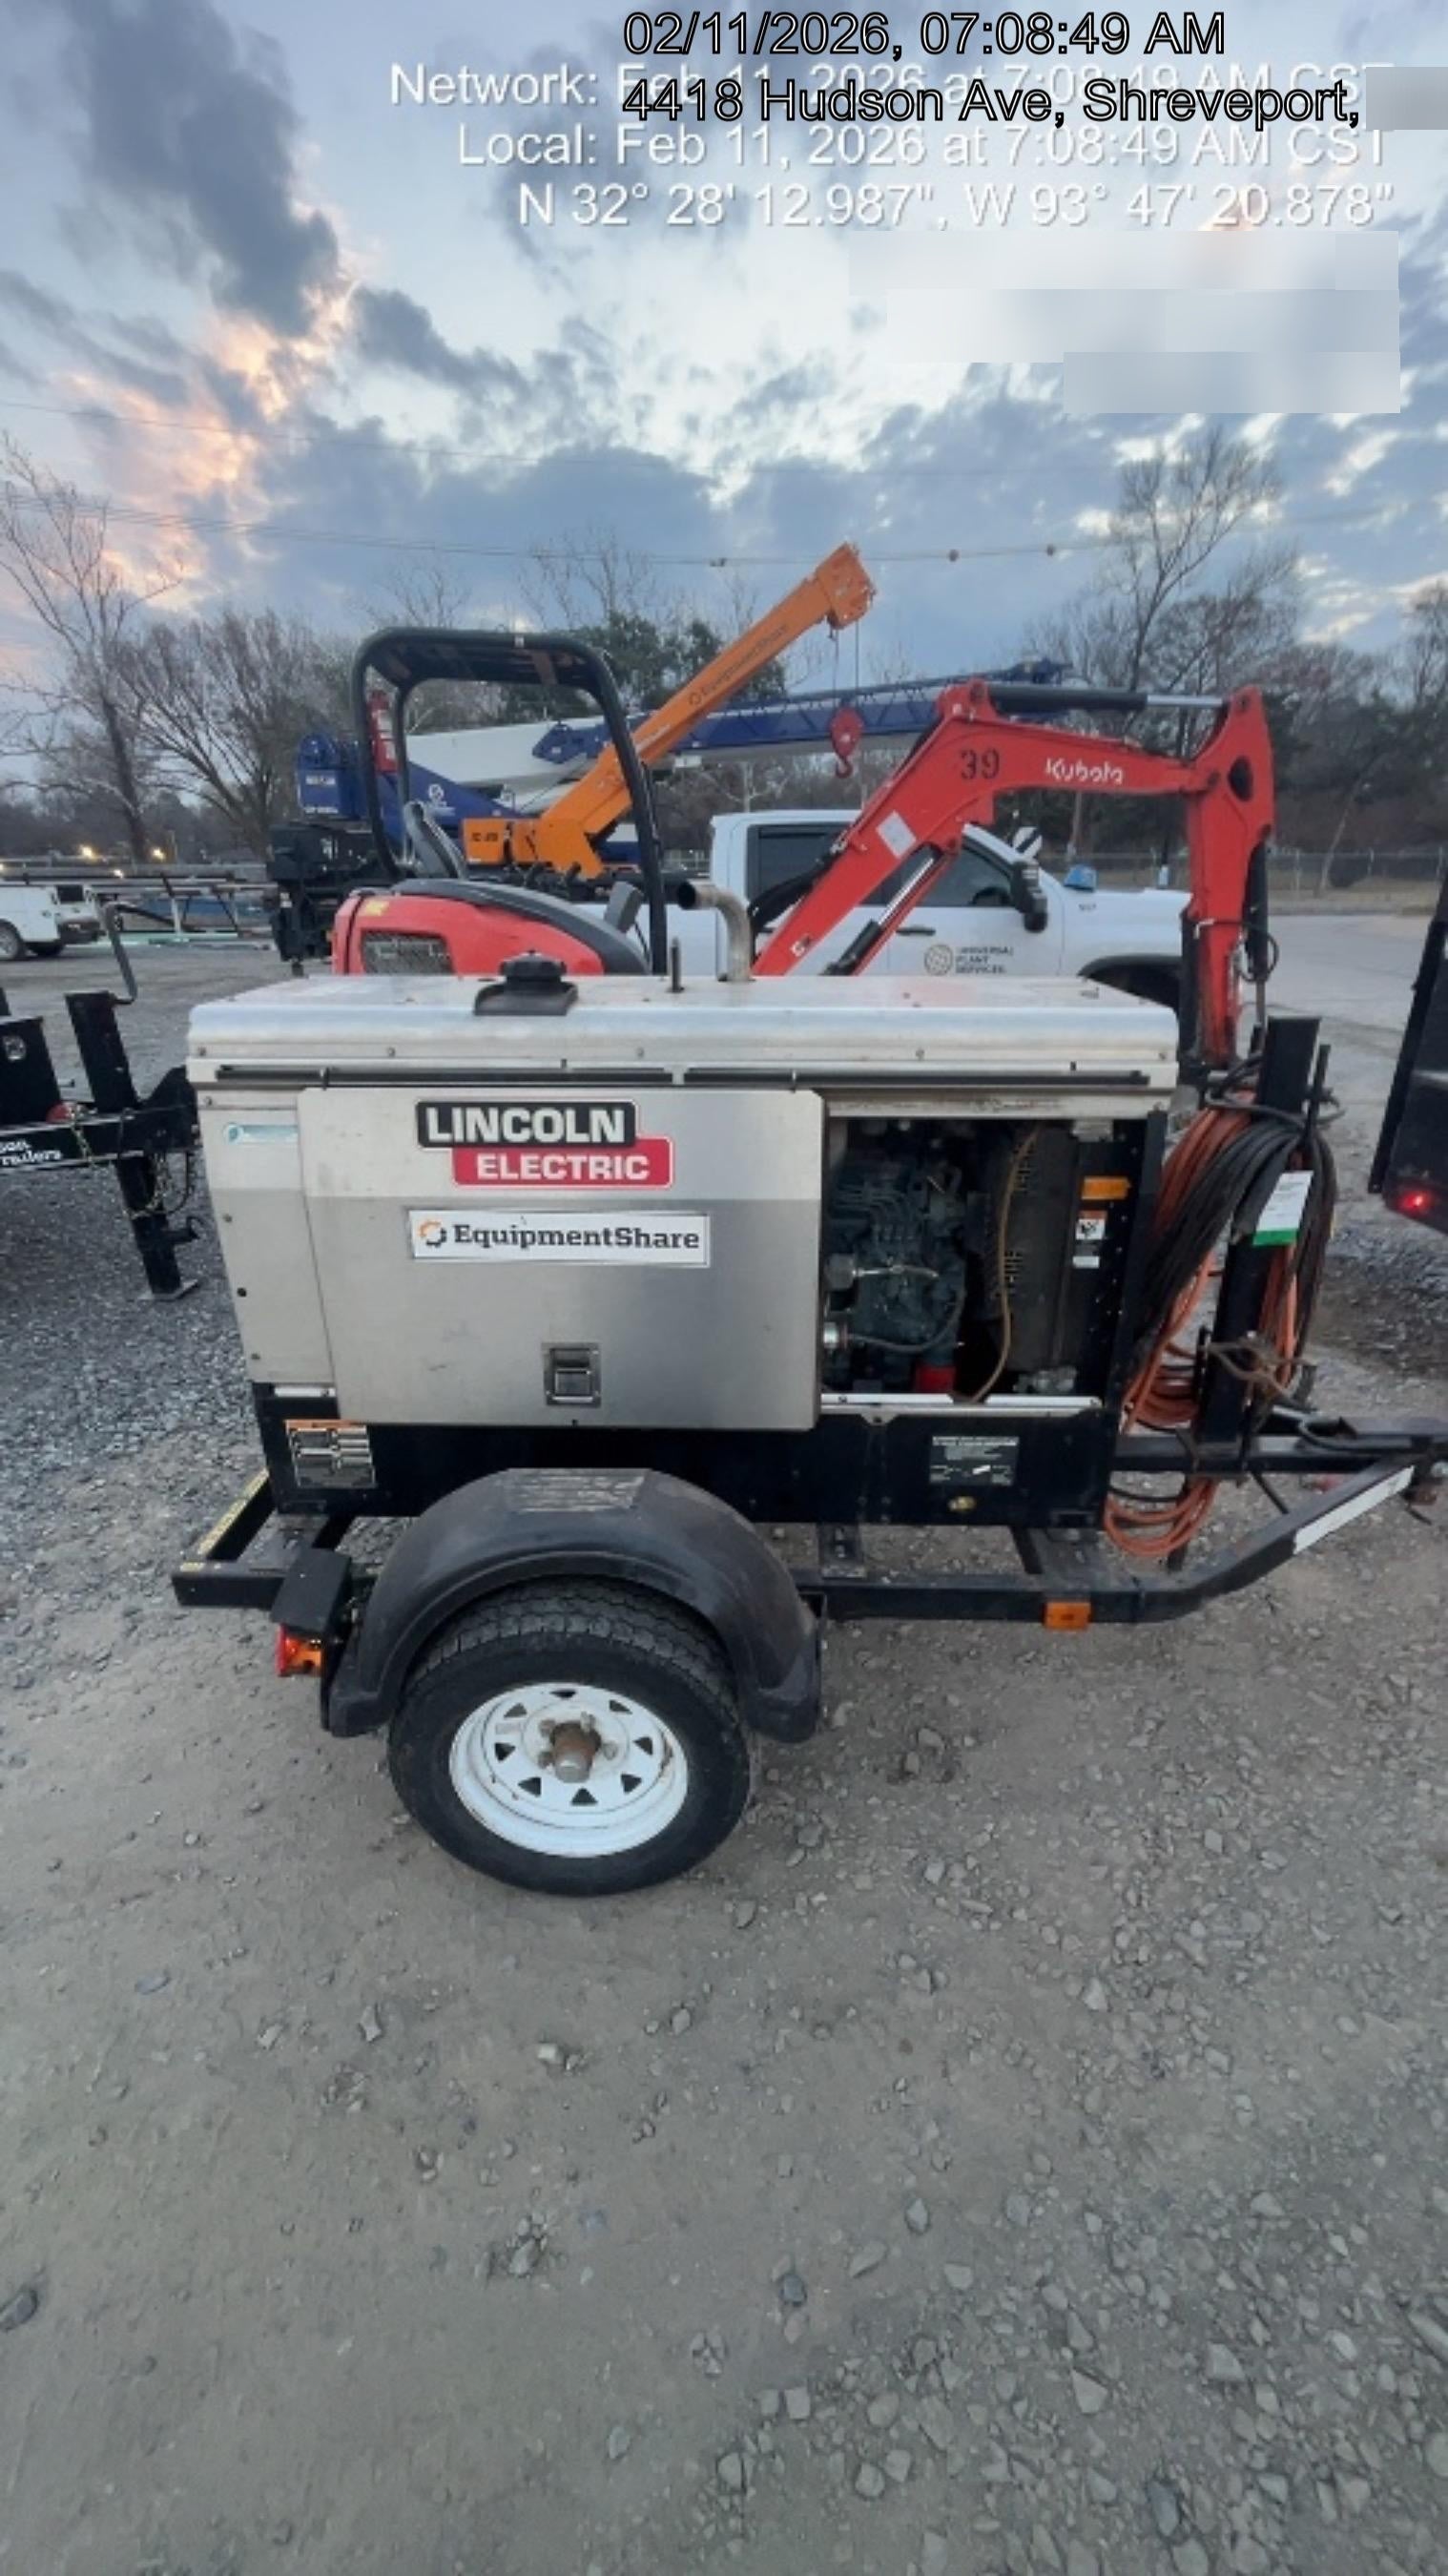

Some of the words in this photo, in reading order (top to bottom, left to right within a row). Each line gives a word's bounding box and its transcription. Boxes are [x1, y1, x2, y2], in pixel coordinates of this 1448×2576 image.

[961, 748, 1001, 780] 39
[1045, 757, 1124, 785] Kubota
[425, 1107, 625, 1144] LINCOLN
[477, 1153, 650, 1181] ELECTRIC
[452, 1224, 700, 1251] EquipmentShare
